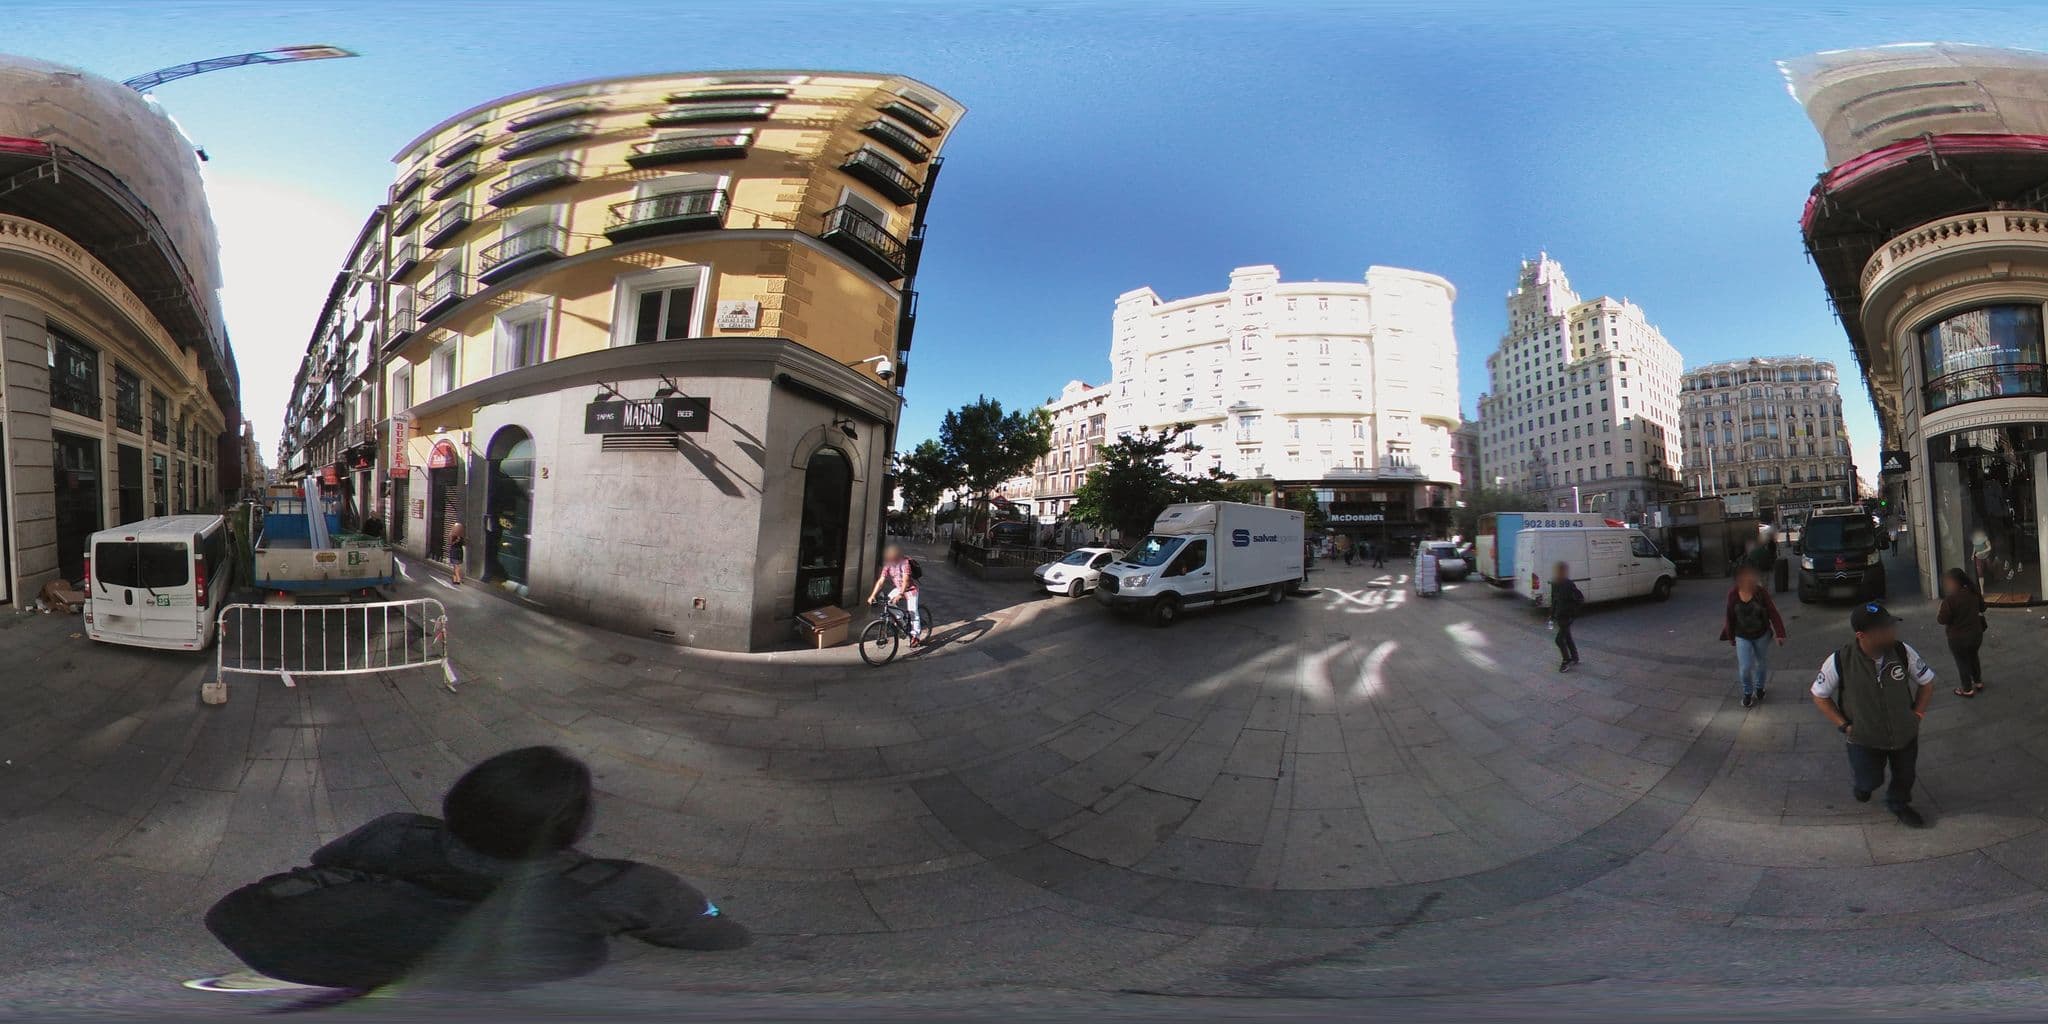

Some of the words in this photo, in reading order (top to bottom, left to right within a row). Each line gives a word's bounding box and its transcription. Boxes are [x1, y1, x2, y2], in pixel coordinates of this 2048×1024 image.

[596, 413, 615, 421] TAPAS
[623, 403, 664, 426] MADRID
[395, 423, 404, 467] BUFFET
[541, 467, 549, 479] 2
[1331, 514, 1385, 522] McDonald's
[1524, 519, 1542, 528] 902
[1545, 519, 1557, 528] 88
[1559, 519, 1570, 528] 99
[1572, 519, 1584, 528] 43
